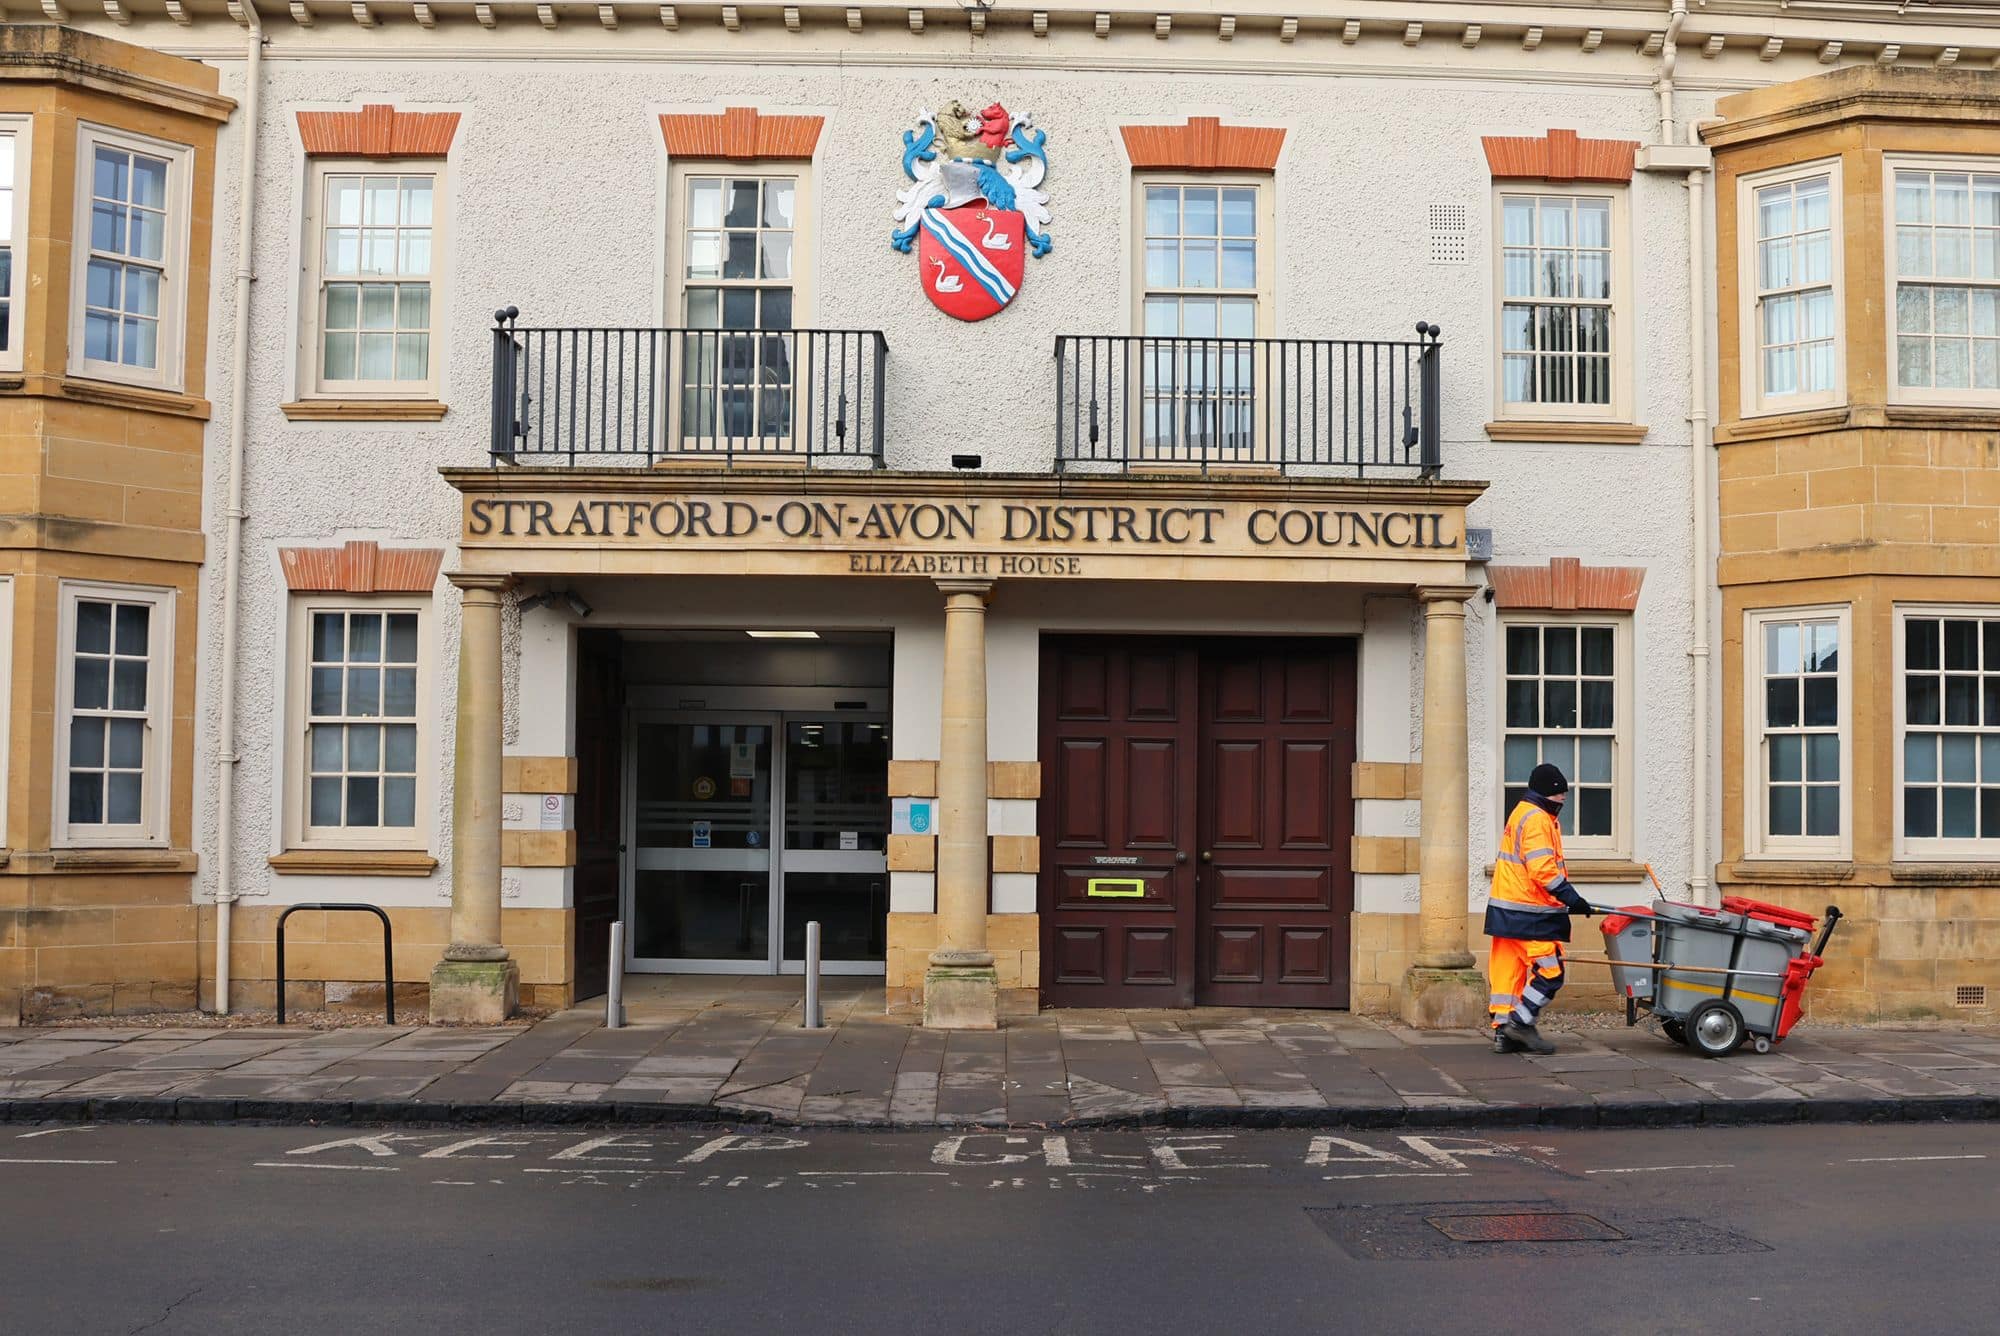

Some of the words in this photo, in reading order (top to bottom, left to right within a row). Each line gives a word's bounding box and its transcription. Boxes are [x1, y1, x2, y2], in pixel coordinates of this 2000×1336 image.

[469, 500, 979, 540] STRATFORD-ON-AVON
[1001, 505, 1225, 544] DISTRICT
[1246, 508, 1458, 549] COUNCIL
[848, 554, 989, 575] ELIZABETH
[1000, 555, 1082, 575] HOUSE
[285, 1132, 810, 1163] KEEP
